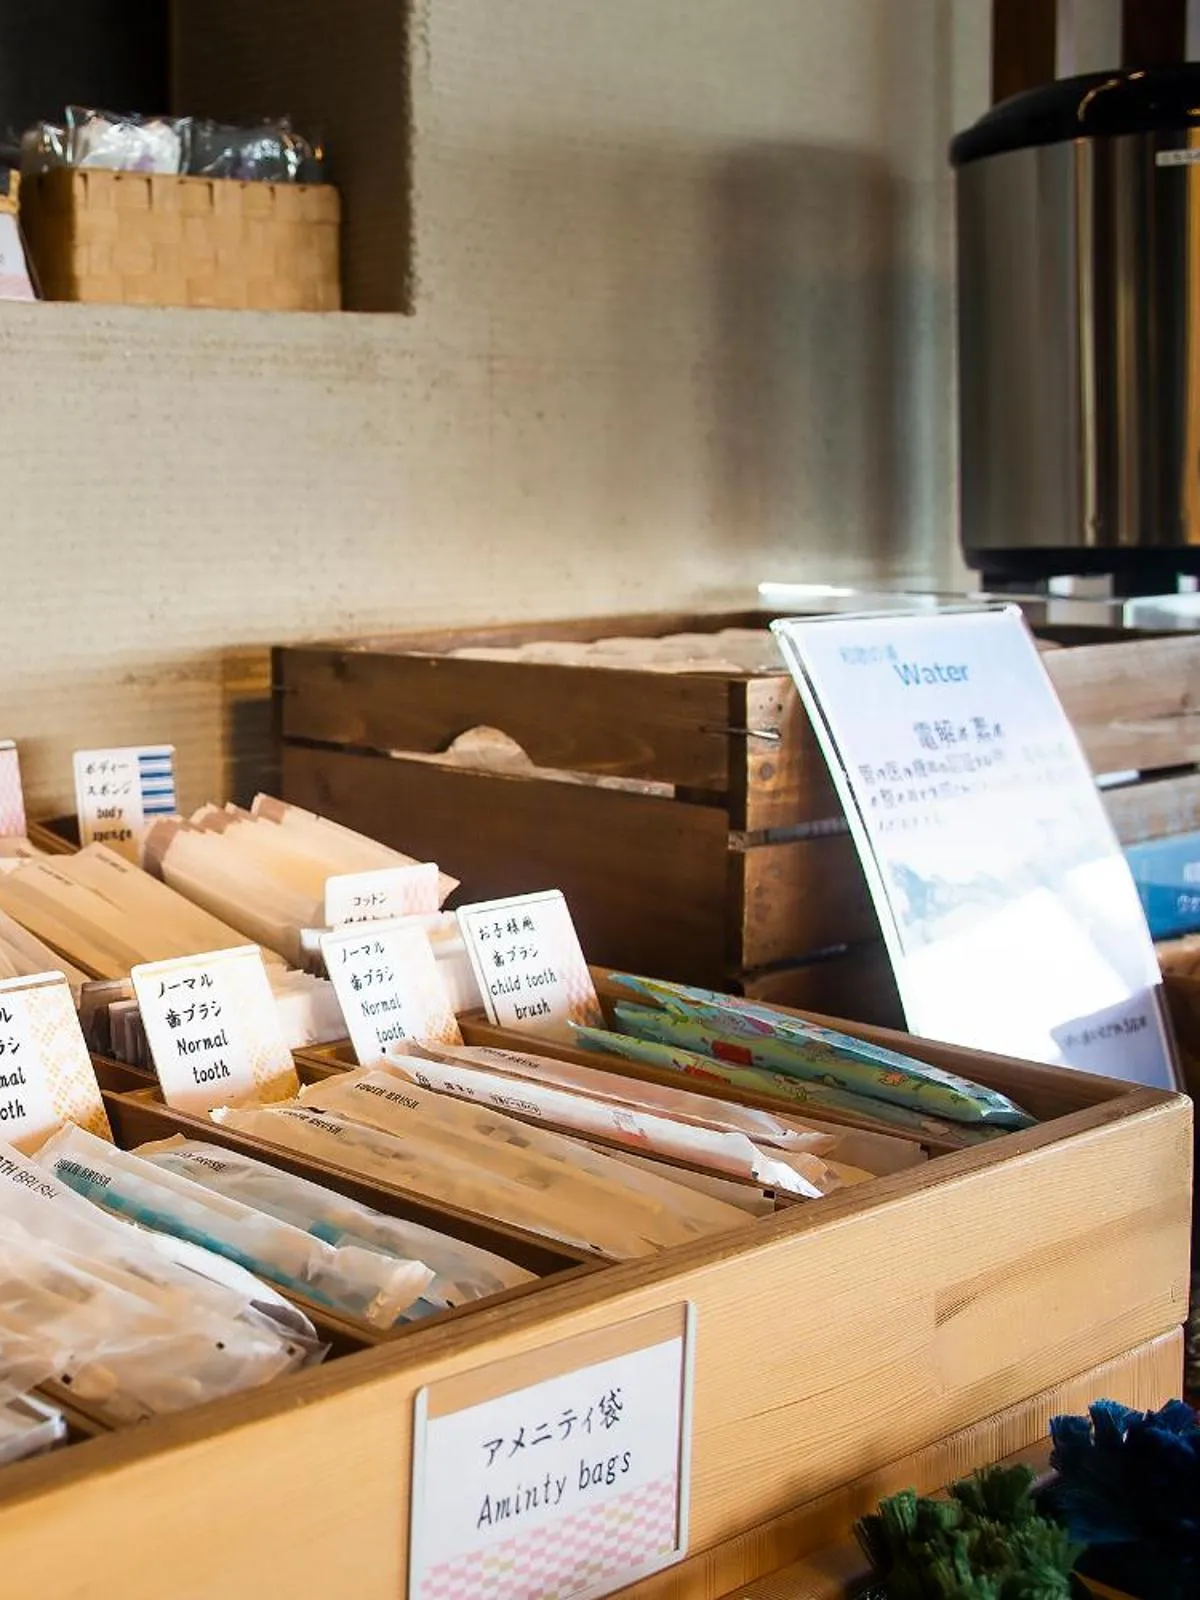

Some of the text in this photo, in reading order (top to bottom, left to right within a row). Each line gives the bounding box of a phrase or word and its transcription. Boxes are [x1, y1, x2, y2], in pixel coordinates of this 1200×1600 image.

[894, 663, 970, 687] Water
[352, 891, 388, 907] コットン
[479, 916, 537, 941] お子様用
[342, 941, 386, 964] ノーマル
[492, 947, 539, 969] 歯ブラシ
[158, 973, 213, 998] ノーマル
[350, 966, 395, 992] 歯ブラシ
[490, 967, 557, 998] child tooth
[165, 1001, 222, 1028] 歯ブラシ
[360, 995, 402, 1018] Normal
[515, 1000, 551, 1020] brush
[176, 1028, 229, 1056] Normal
[376, 1025, 406, 1044] tooth
[192, 1061, 231, 1084] tooth
[385, 1090, 420, 1110] BRUSH
[12, 1169, 61, 1200] BRUSH
[482, 1387, 623, 1467] アメニティ袋
[476, 1450, 632, 1530] Aminty bags
